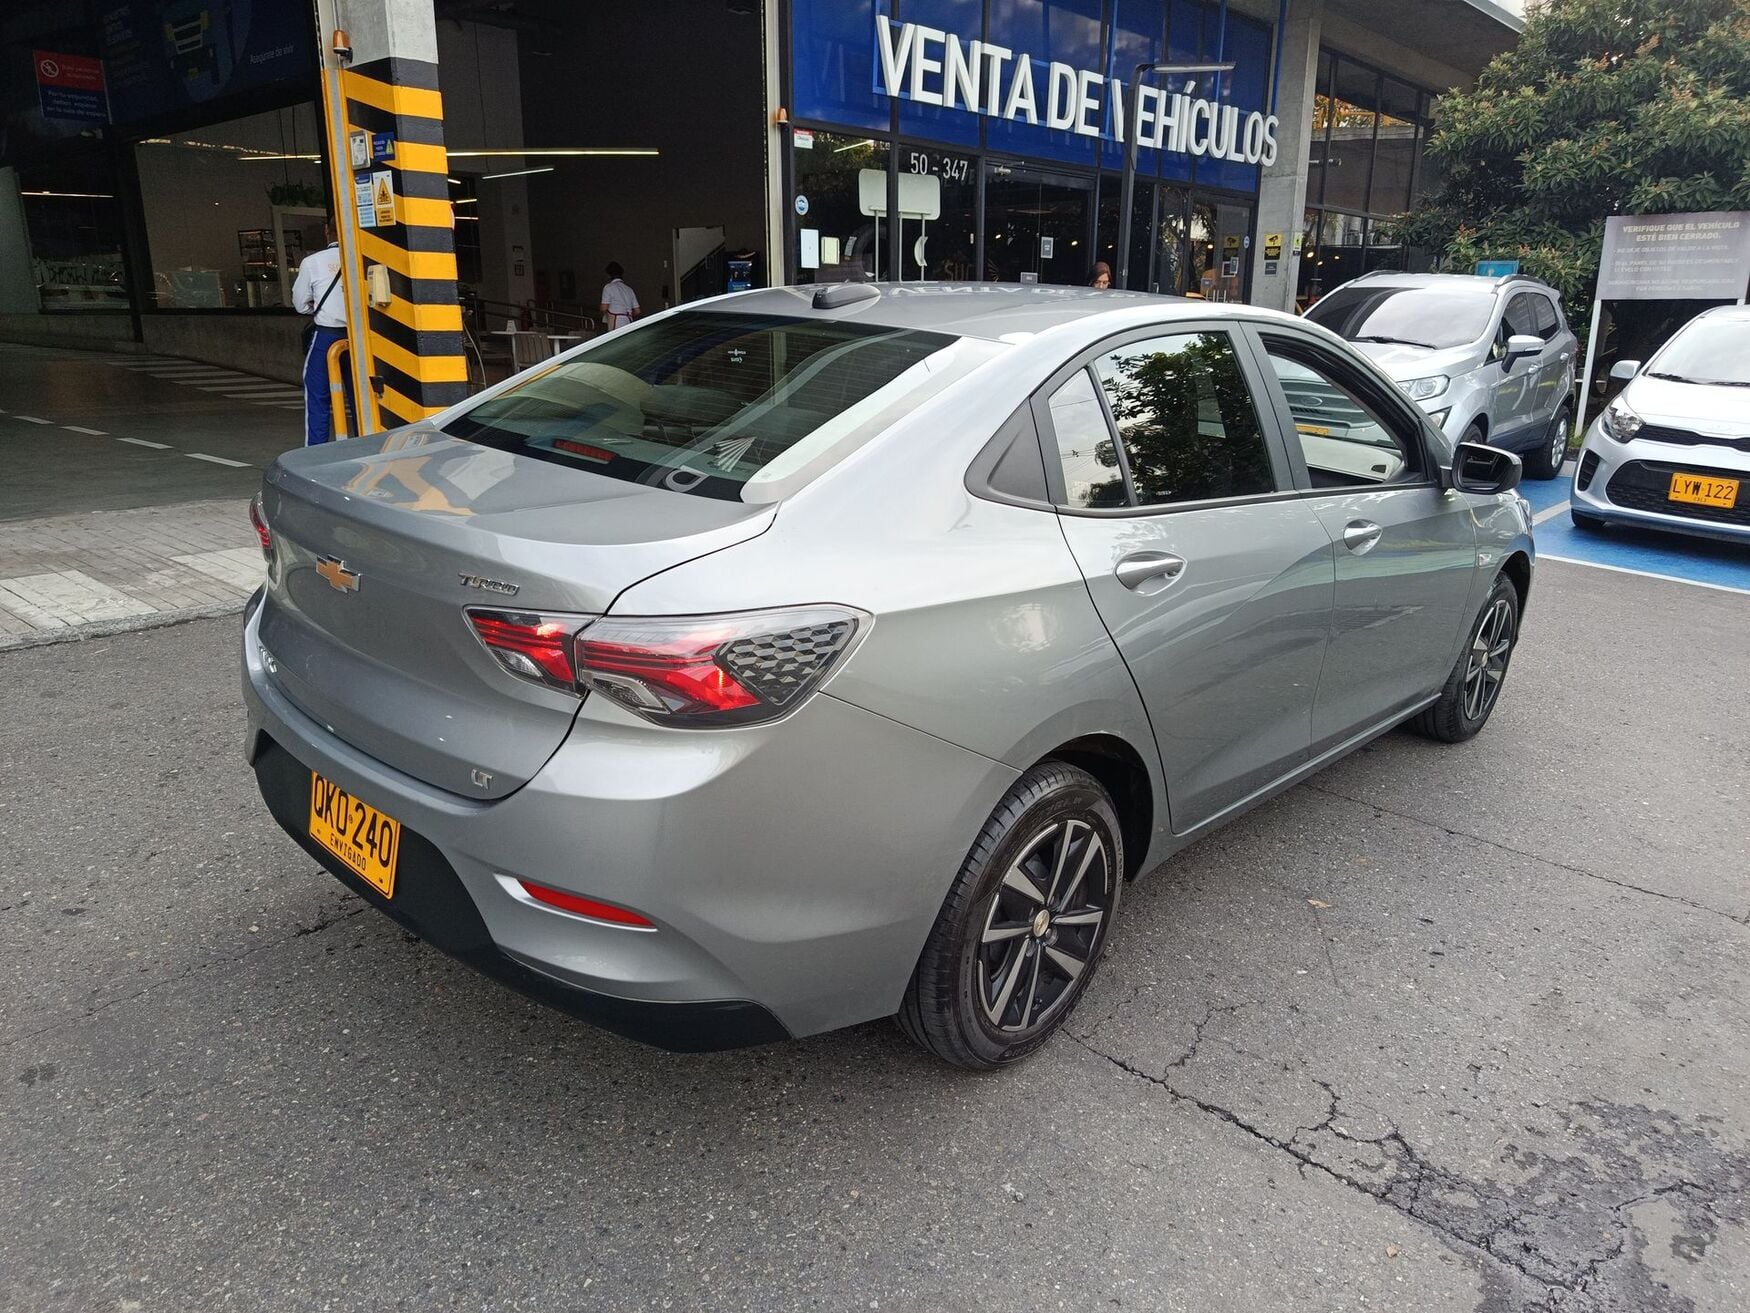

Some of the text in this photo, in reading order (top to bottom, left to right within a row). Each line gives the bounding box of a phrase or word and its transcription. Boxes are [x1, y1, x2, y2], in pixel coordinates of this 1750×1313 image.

[876, 14, 1038, 125] VENTA
[1046, 61, 1104, 137] DE
[910, 152, 928, 175] 50
[942, 157, 968, 181] 347
[1622, 224, 1666, 233] VERIFIQUE
[1666, 223, 1684, 231] QUE
[1685, 223, 1696, 231] EL
[1658, 233, 1678, 241] BIEN
[1672, 478, 1734, 500] LYW 122
[471, 769, 493, 790] LT
[352, 802, 393, 868] 240
[330, 833, 367, 871] ENVIGADO
